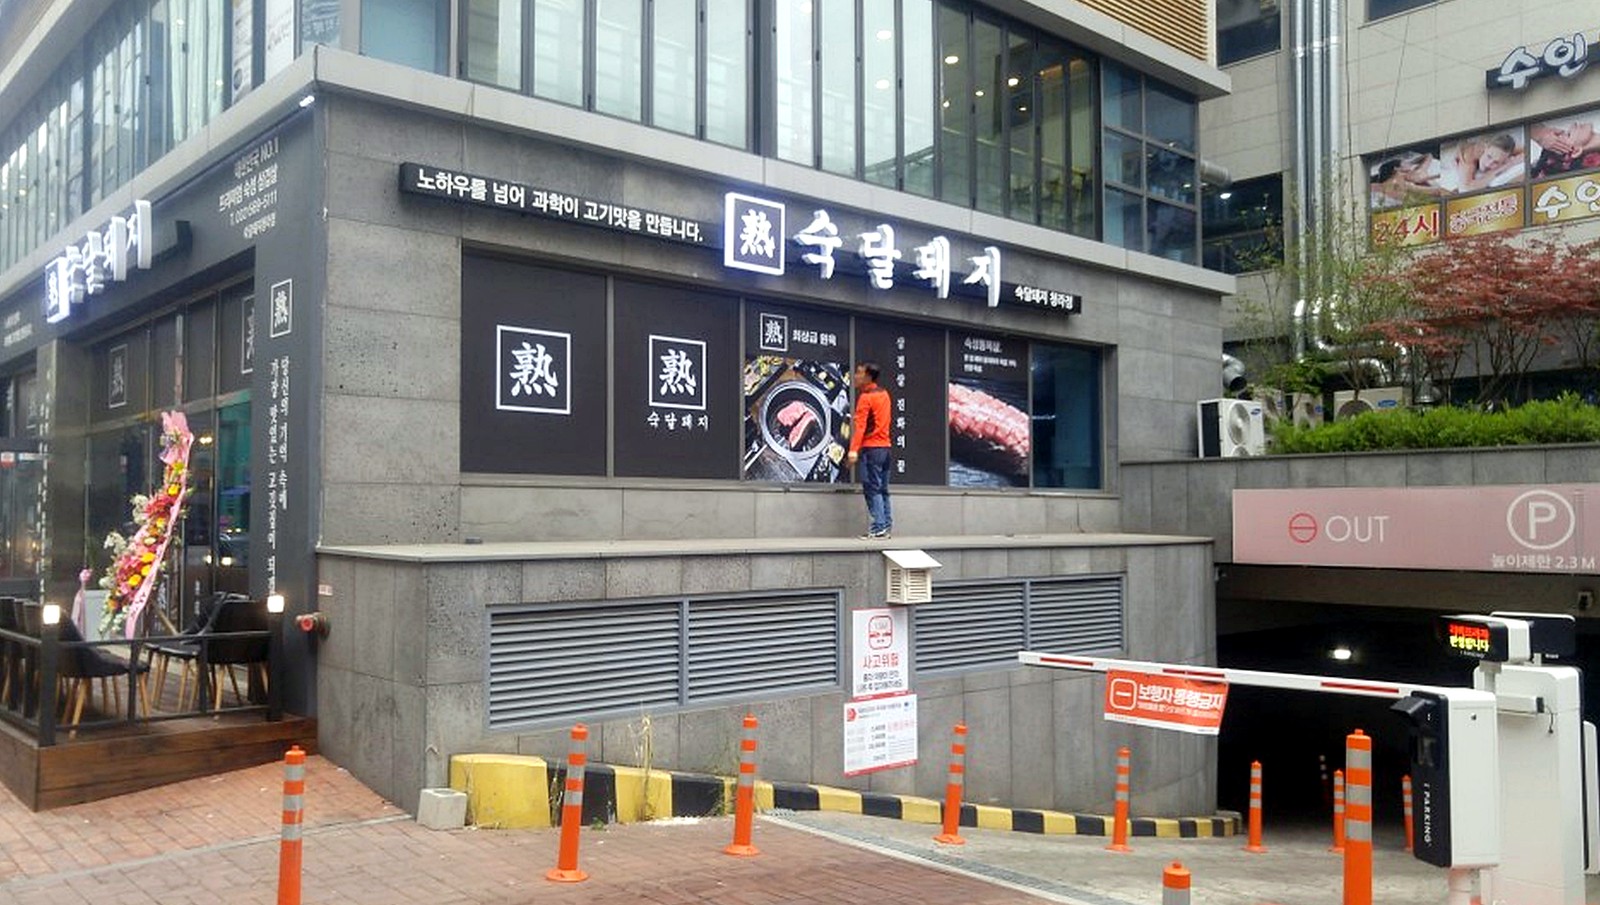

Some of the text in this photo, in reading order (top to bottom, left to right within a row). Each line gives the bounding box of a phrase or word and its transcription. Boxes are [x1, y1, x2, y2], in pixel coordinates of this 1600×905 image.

[1497, 33, 1588, 89] 수인
[416, 168, 704, 243] 노하우를 넘어 과학이 고기맛을 만듭니다.
[1373, 210, 1439, 245] 24시
[793, 207, 1001, 308] 숙달돼지
[1014, 285, 1048, 306] 숙달돼지
[510, 342, 559, 397] 熟
[659, 348, 697, 396] 熟
[1326, 516, 1390, 542] OUT
[1528, 501, 1557, 540] P
[1493, 553, 1596, 570] 높이제한 2.3 M
[863, 652, 899, 668] 사고위험
[1138, 683, 1173, 704] 보행자
[1173, 688, 1223, 711] 통행금지
